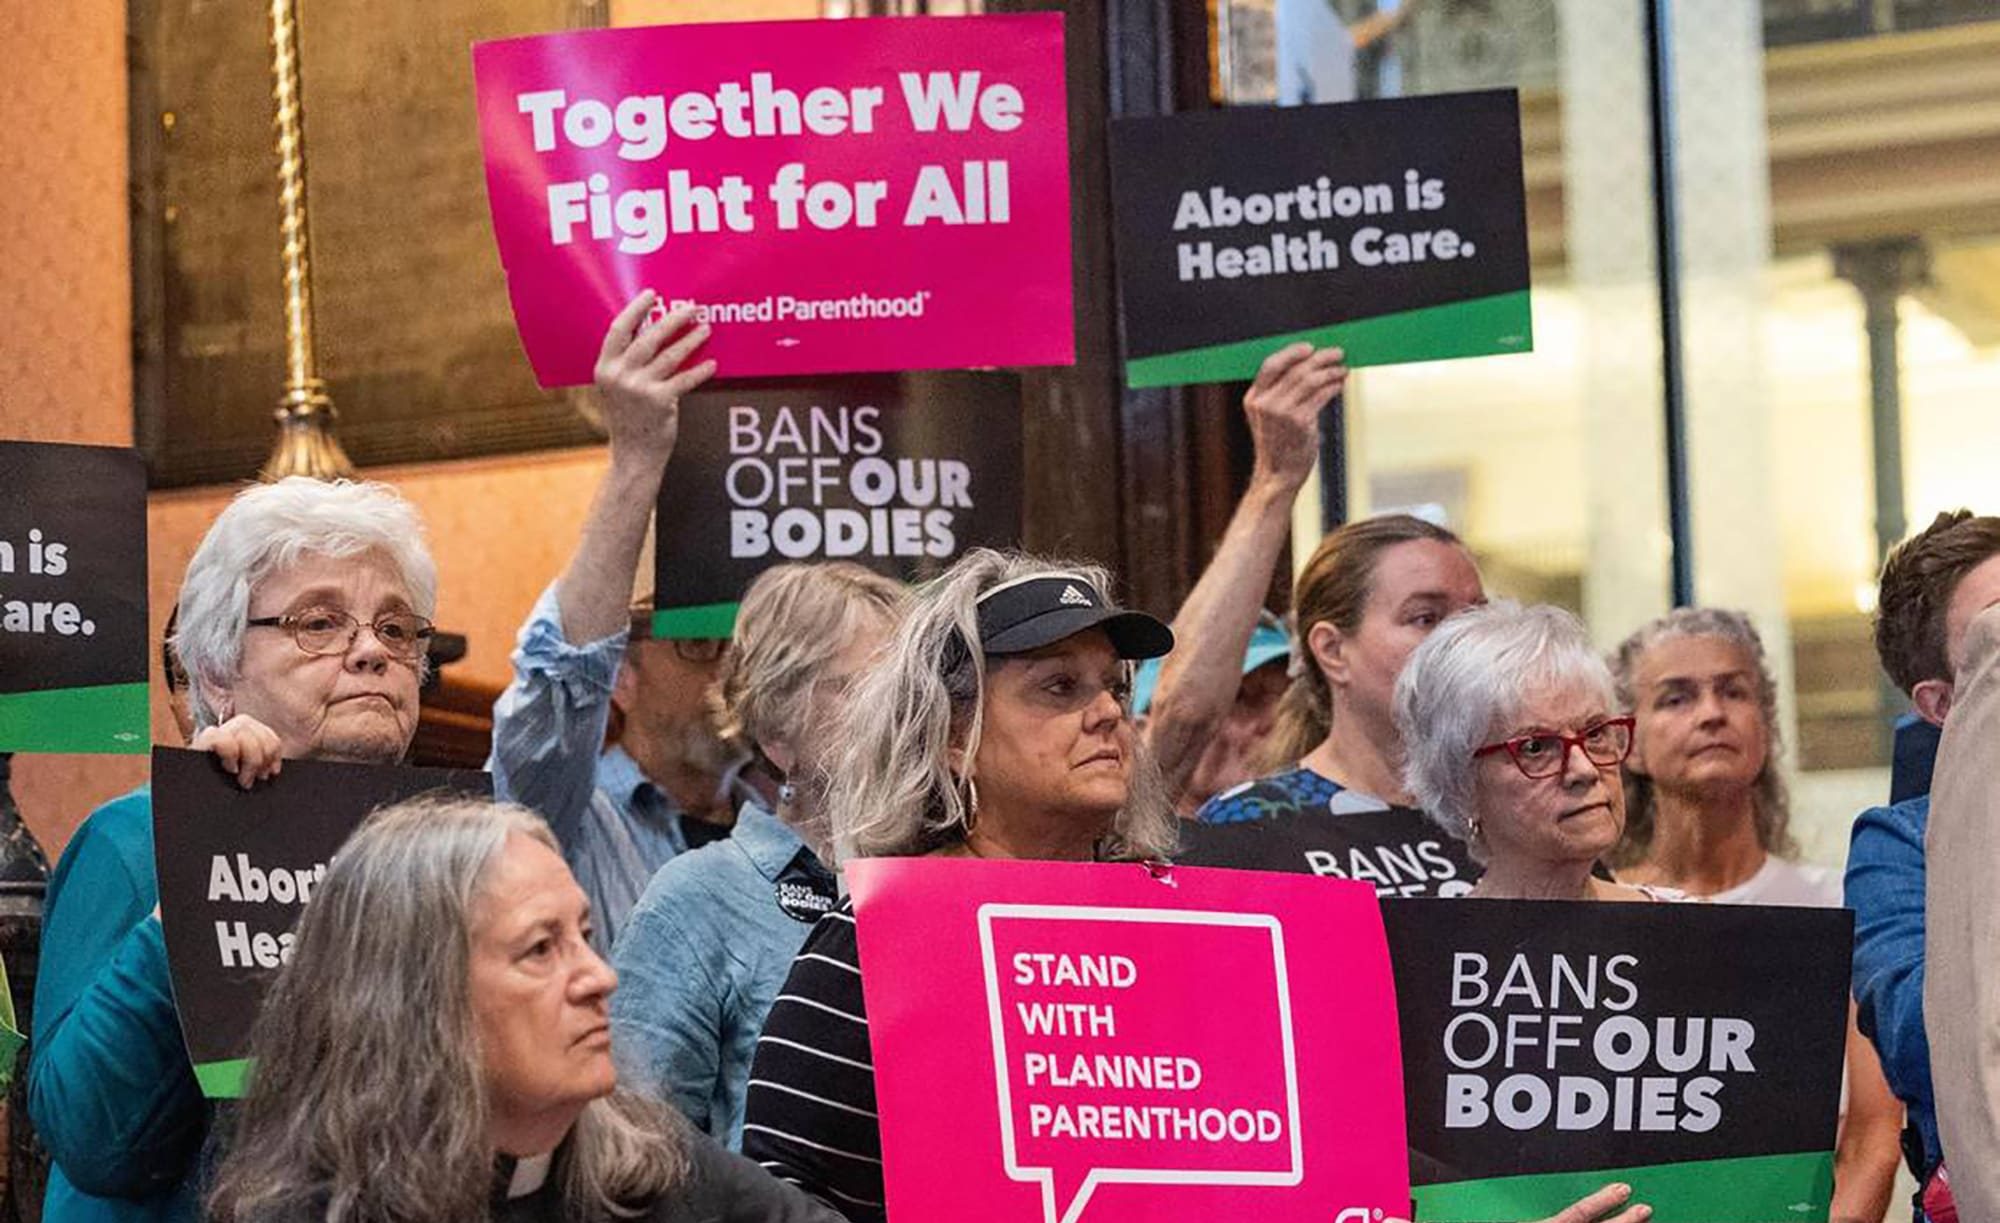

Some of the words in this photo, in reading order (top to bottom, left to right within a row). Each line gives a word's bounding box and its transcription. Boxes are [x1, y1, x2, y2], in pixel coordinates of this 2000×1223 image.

[517, 72, 884, 161] Together
[899, 71, 1025, 132] We
[546, 169, 755, 255] Fight
[769, 163, 888, 230] for
[903, 160, 1011, 226] All
[1172, 176, 1394, 231] Abortion
[1404, 169, 1446, 211] is
[1177, 229, 1340, 282] Health
[1350, 227, 1476, 267] Care.
[776, 291, 924, 321] Parenthood
[728, 405, 884, 456] BANS
[725, 456, 842, 508] OFF
[849, 456, 974, 508] OUR
[28, 528, 69, 577] is
[729, 507, 956, 559] BODIES
[0, 594, 97, 636] are.
[1303, 840, 1458, 885] BANS
[1013, 952, 1138, 989] STAND
[1450, 952, 1640, 1012] BANS
[1016, 1002, 1116, 1038] WITH
[1443, 1012, 1584, 1070] OFF
[1593, 1015, 1757, 1073] OUR
[1025, 1053, 1203, 1091] PLANNED
[1029, 1104, 1283, 1143] PARENTHOOD
[1444, 1073, 1725, 1134] BODIES
